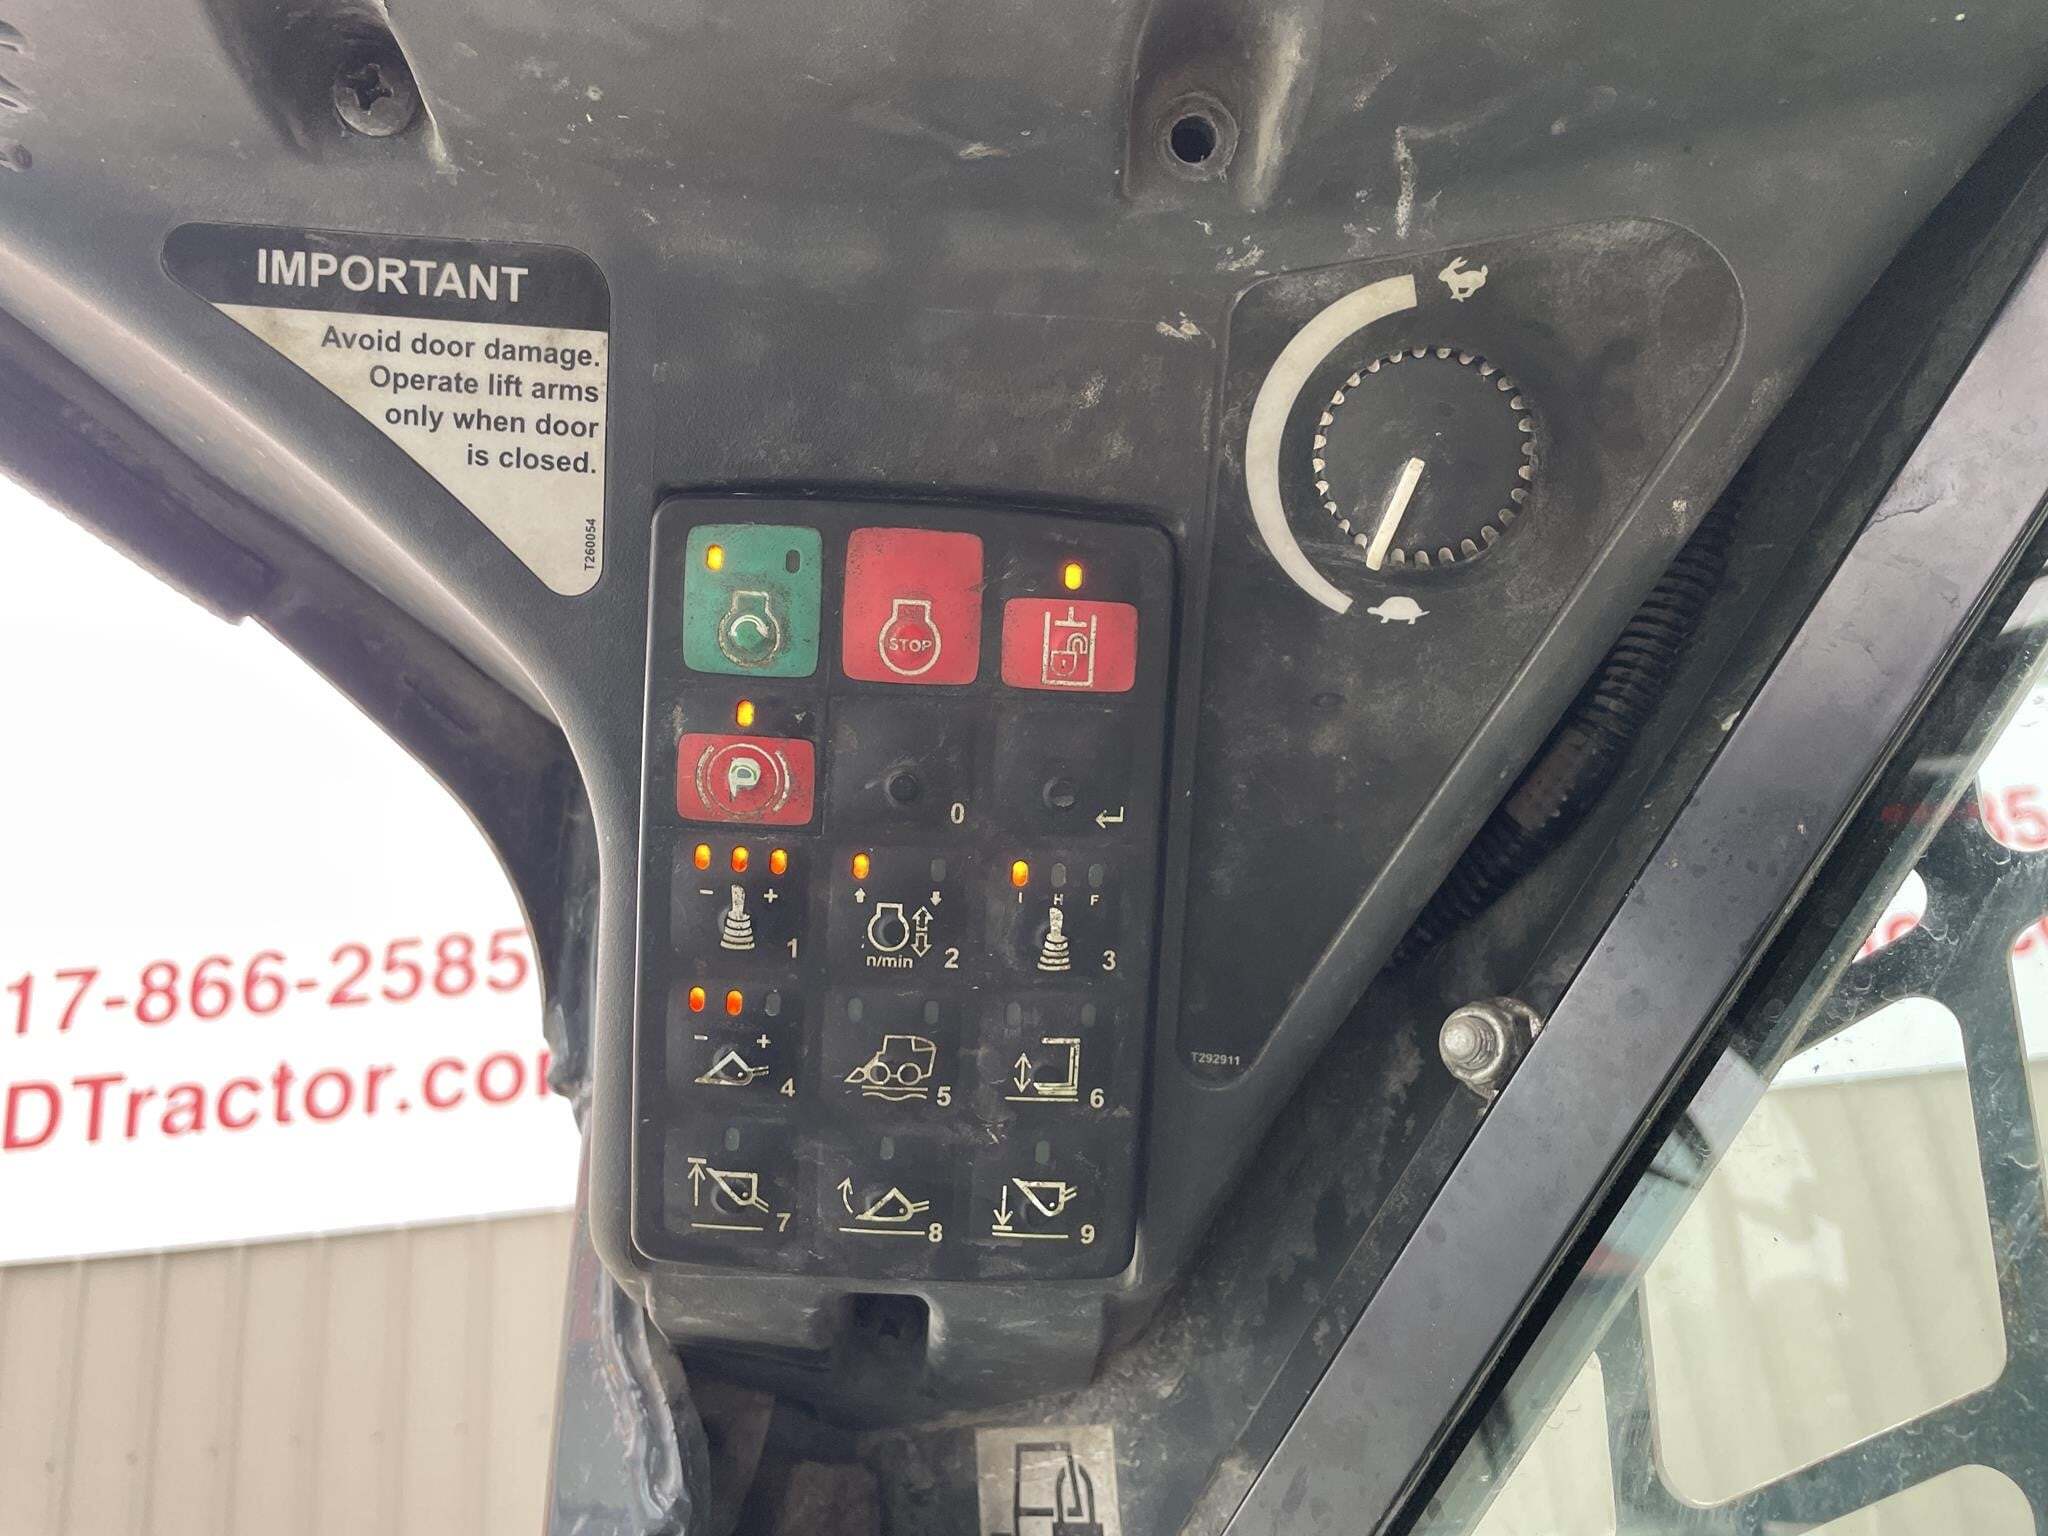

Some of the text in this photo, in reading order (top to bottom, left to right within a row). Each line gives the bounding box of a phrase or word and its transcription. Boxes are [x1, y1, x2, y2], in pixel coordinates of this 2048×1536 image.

[257, 248, 529, 303] IMPORTANT
[321, 325, 601, 370] Avoid door damage.
[369, 365, 599, 403] Operate lift arms
[385, 405, 600, 438] only when door
[466, 443, 597, 474] is closed.
[584, 518, 596, 571] T260054
[888, 637, 933, 653] STOP
[727, 757, 762, 802] P
[949, 803, 966, 825] 0
[1053, 893, 1064, 906] H
[1089, 894, 1100, 906] F
[786, 938, 799, 958] 1
[865, 953, 914, 970] n/min
[943, 949, 960, 969] 2
[1101, 949, 1117, 971] 3
[5, 927, 530, 1036] 17-866-2585
[1190, 1051, 1241, 1066] T292911
[780, 1077, 796, 1097] 4
[936, 1086, 952, 1107] 5
[1089, 1088, 1105, 1109] 6
[776, 1213, 792, 1232] 7
[927, 1223, 944, 1243] 8
[1080, 1224, 1095, 1244] 9
